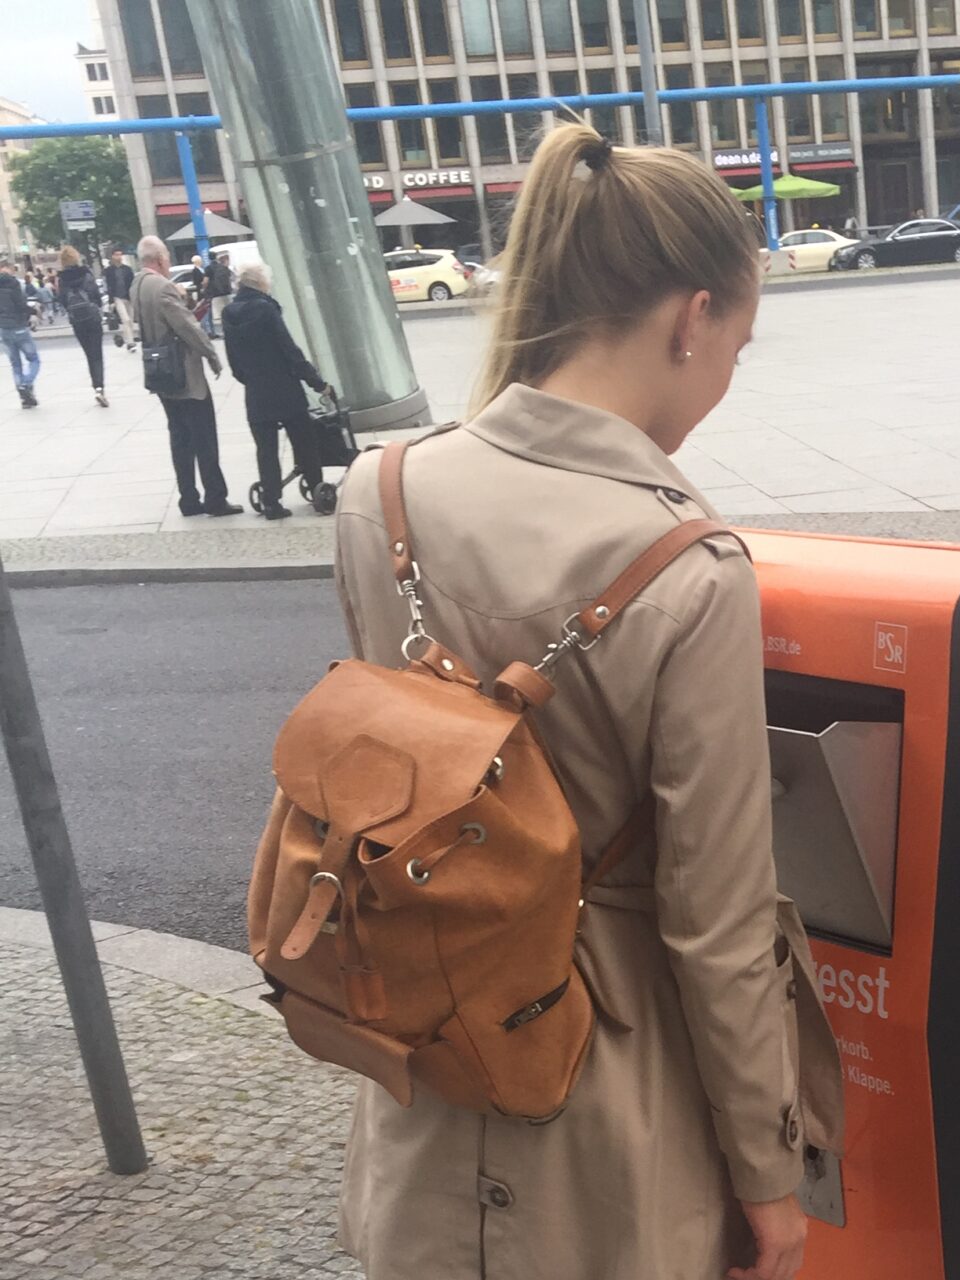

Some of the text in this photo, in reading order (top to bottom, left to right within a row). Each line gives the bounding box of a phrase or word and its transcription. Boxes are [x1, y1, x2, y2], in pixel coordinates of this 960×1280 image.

[403, 170, 471, 187] COFFEE
[878, 631, 903, 664] BSR
[813, 961, 890, 1019] esst
